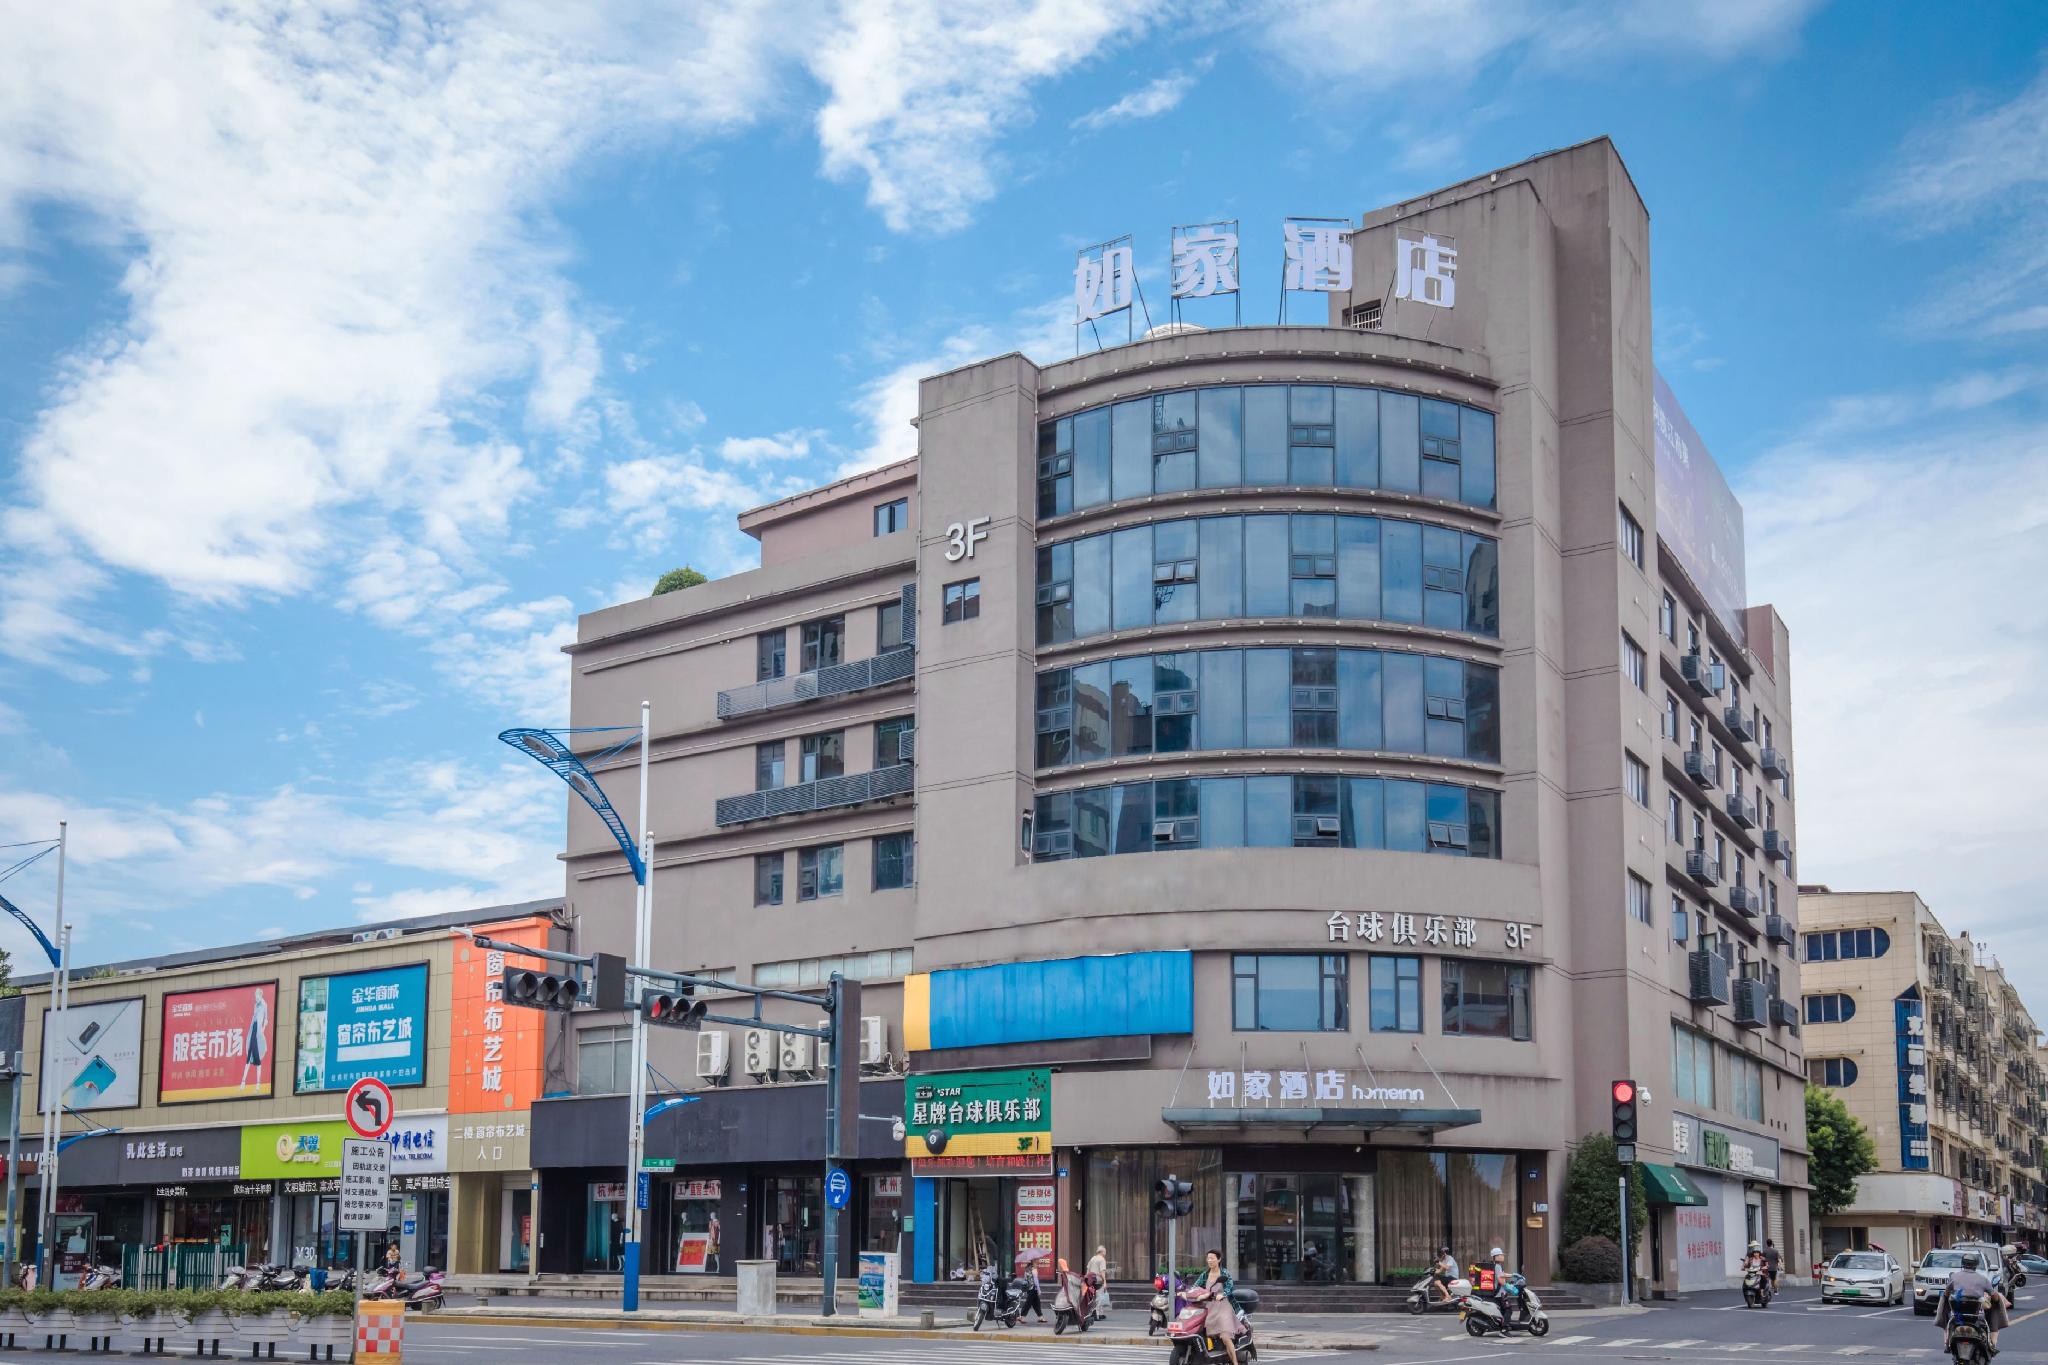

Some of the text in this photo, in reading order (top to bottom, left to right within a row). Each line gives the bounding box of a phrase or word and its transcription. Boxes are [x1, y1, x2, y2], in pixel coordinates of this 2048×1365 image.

[1073, 224, 1457, 325] 如家酒店
[945, 515, 991, 561] 3F
[1326, 911, 1532, 950] 台球俱乐部 3F
[338, 1016, 412, 1046] 窗帘布艺城
[482, 950, 505, 1092] 窗帘布艺城
[172, 1028, 244, 1062] 服装市场
[1208, 1070, 1345, 1100] 如家酒店
[912, 1098, 1041, 1125] 星牌台球俱乐部
[351, 1146, 384, 1158] 施工公告
[391, 1129, 434, 1152] 中国电信
[1019, 1213, 1052, 1222] 三楼部分
[1018, 1231, 1052, 1252] 出租
